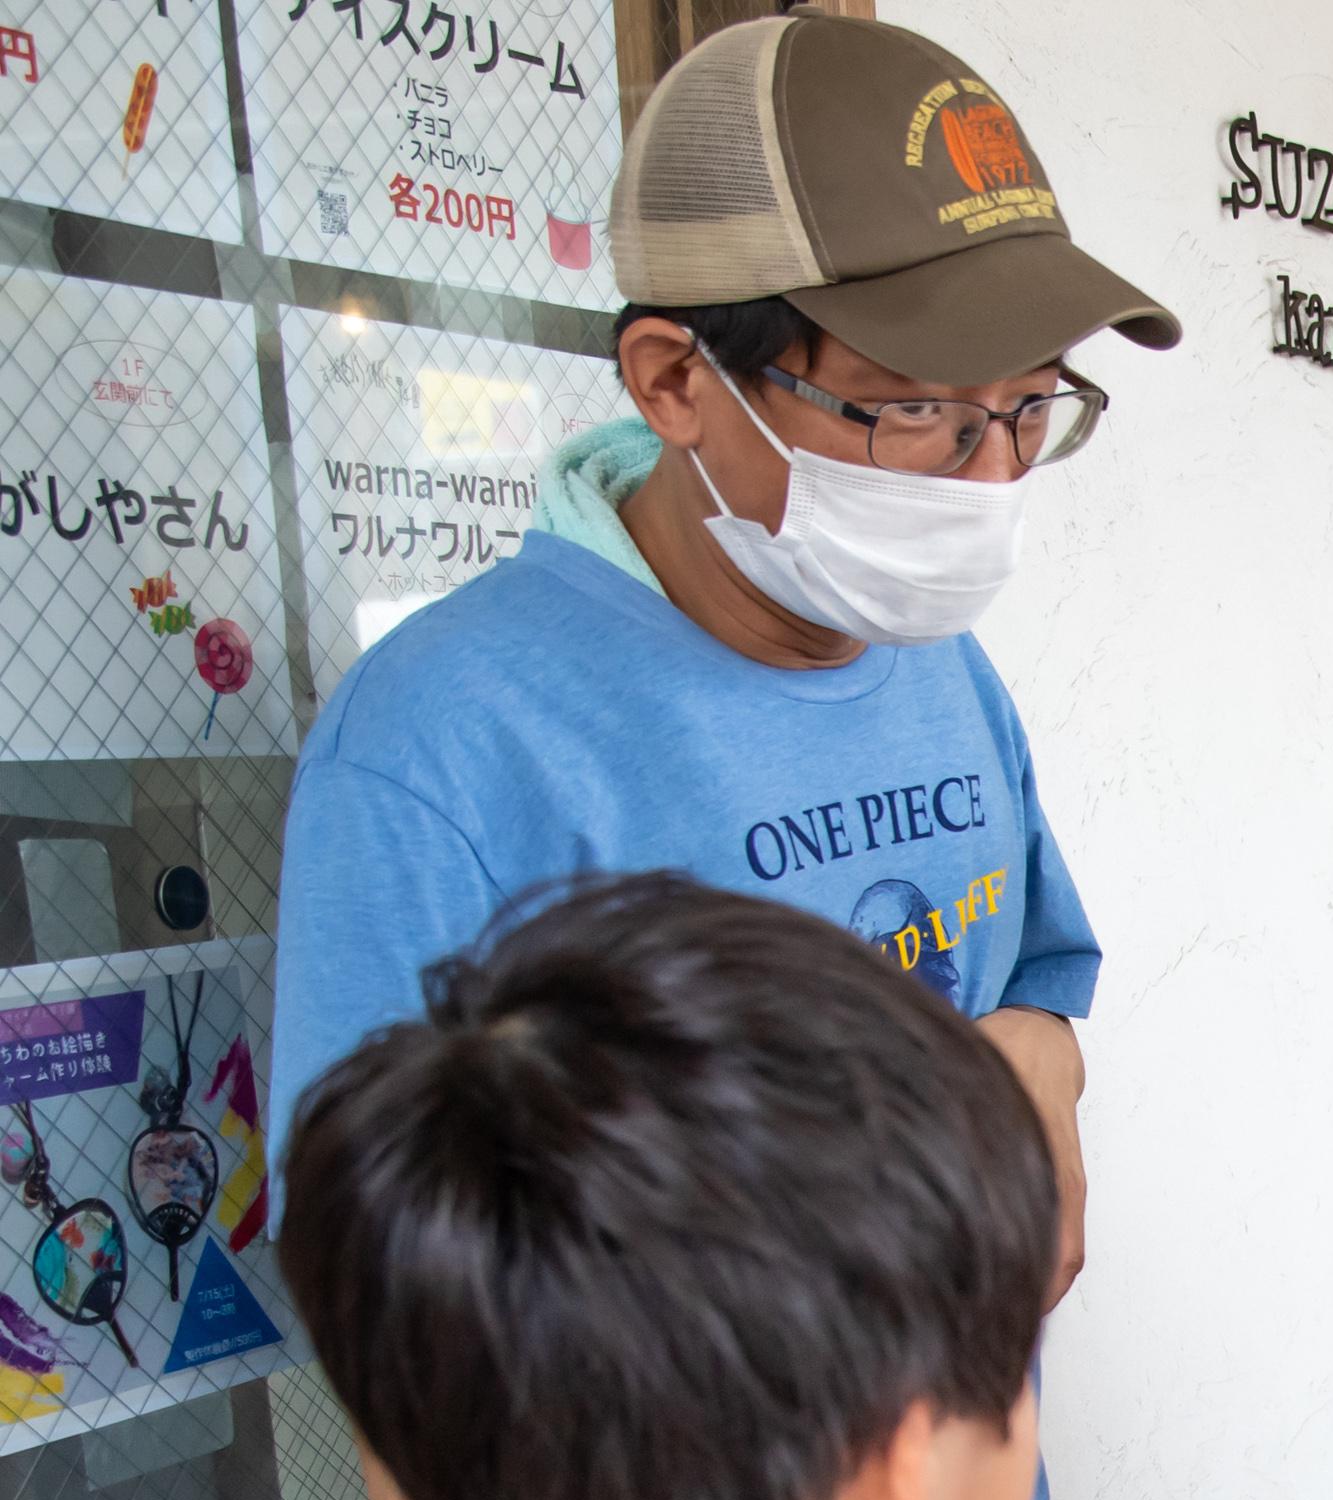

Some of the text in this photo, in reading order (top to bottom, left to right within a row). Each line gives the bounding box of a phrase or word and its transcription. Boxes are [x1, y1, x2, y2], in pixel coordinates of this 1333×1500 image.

[407, 110, 451, 139] チョコ
[411, 140, 503, 176] ストロベリー
[389, 173, 516, 240] 各200円
[745, 774, 986, 881] ONE PIECE
